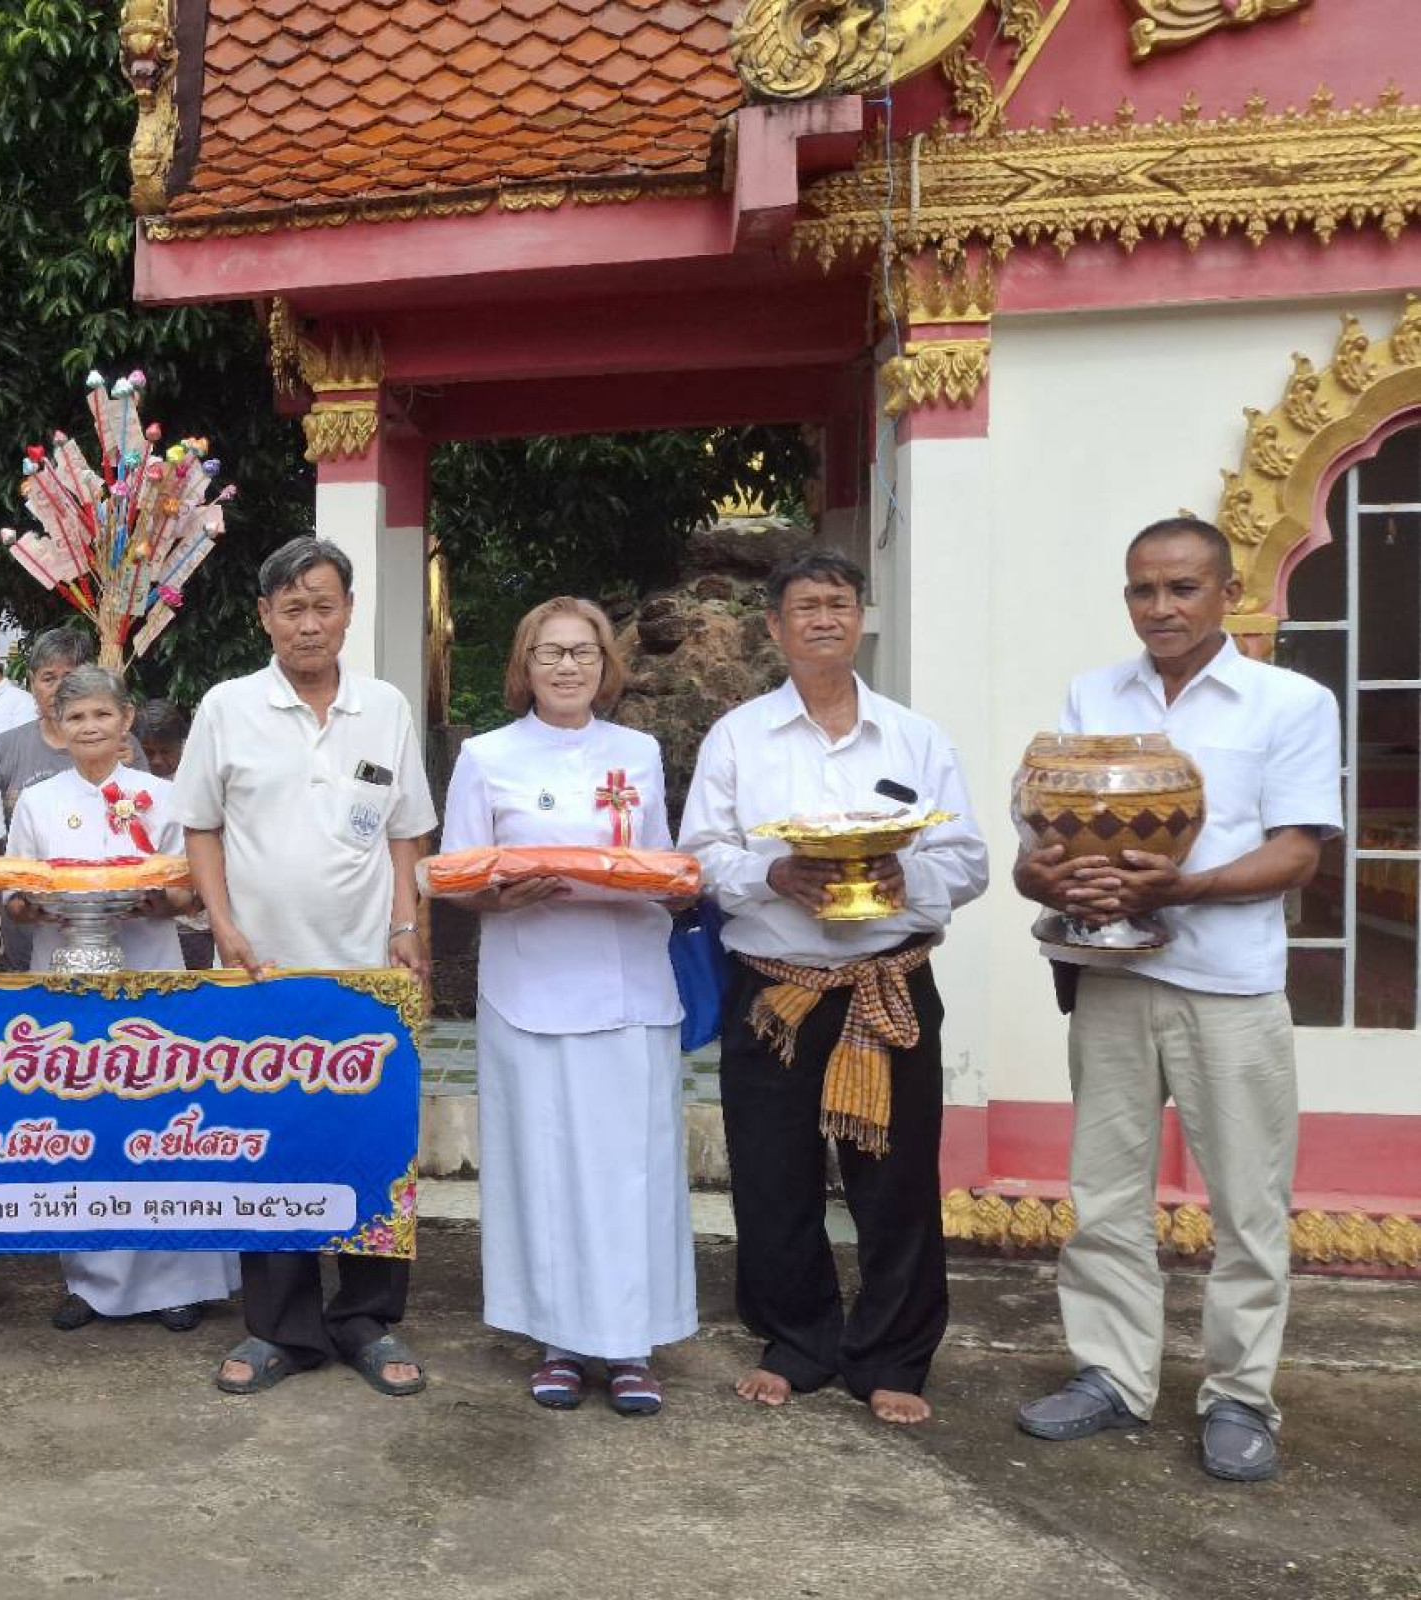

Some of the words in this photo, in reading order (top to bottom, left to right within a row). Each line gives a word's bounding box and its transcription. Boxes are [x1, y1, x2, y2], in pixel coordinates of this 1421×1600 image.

[128, 1109, 267, 1159] จ.ยโสธร
[29, 1186, 78, 1217] วันที่
[88, 1195, 133, 1217] ๑๒
[143, 1197, 223, 1223] ตุลาคม
[233, 1193, 327, 1217] ๒๕๖๘
